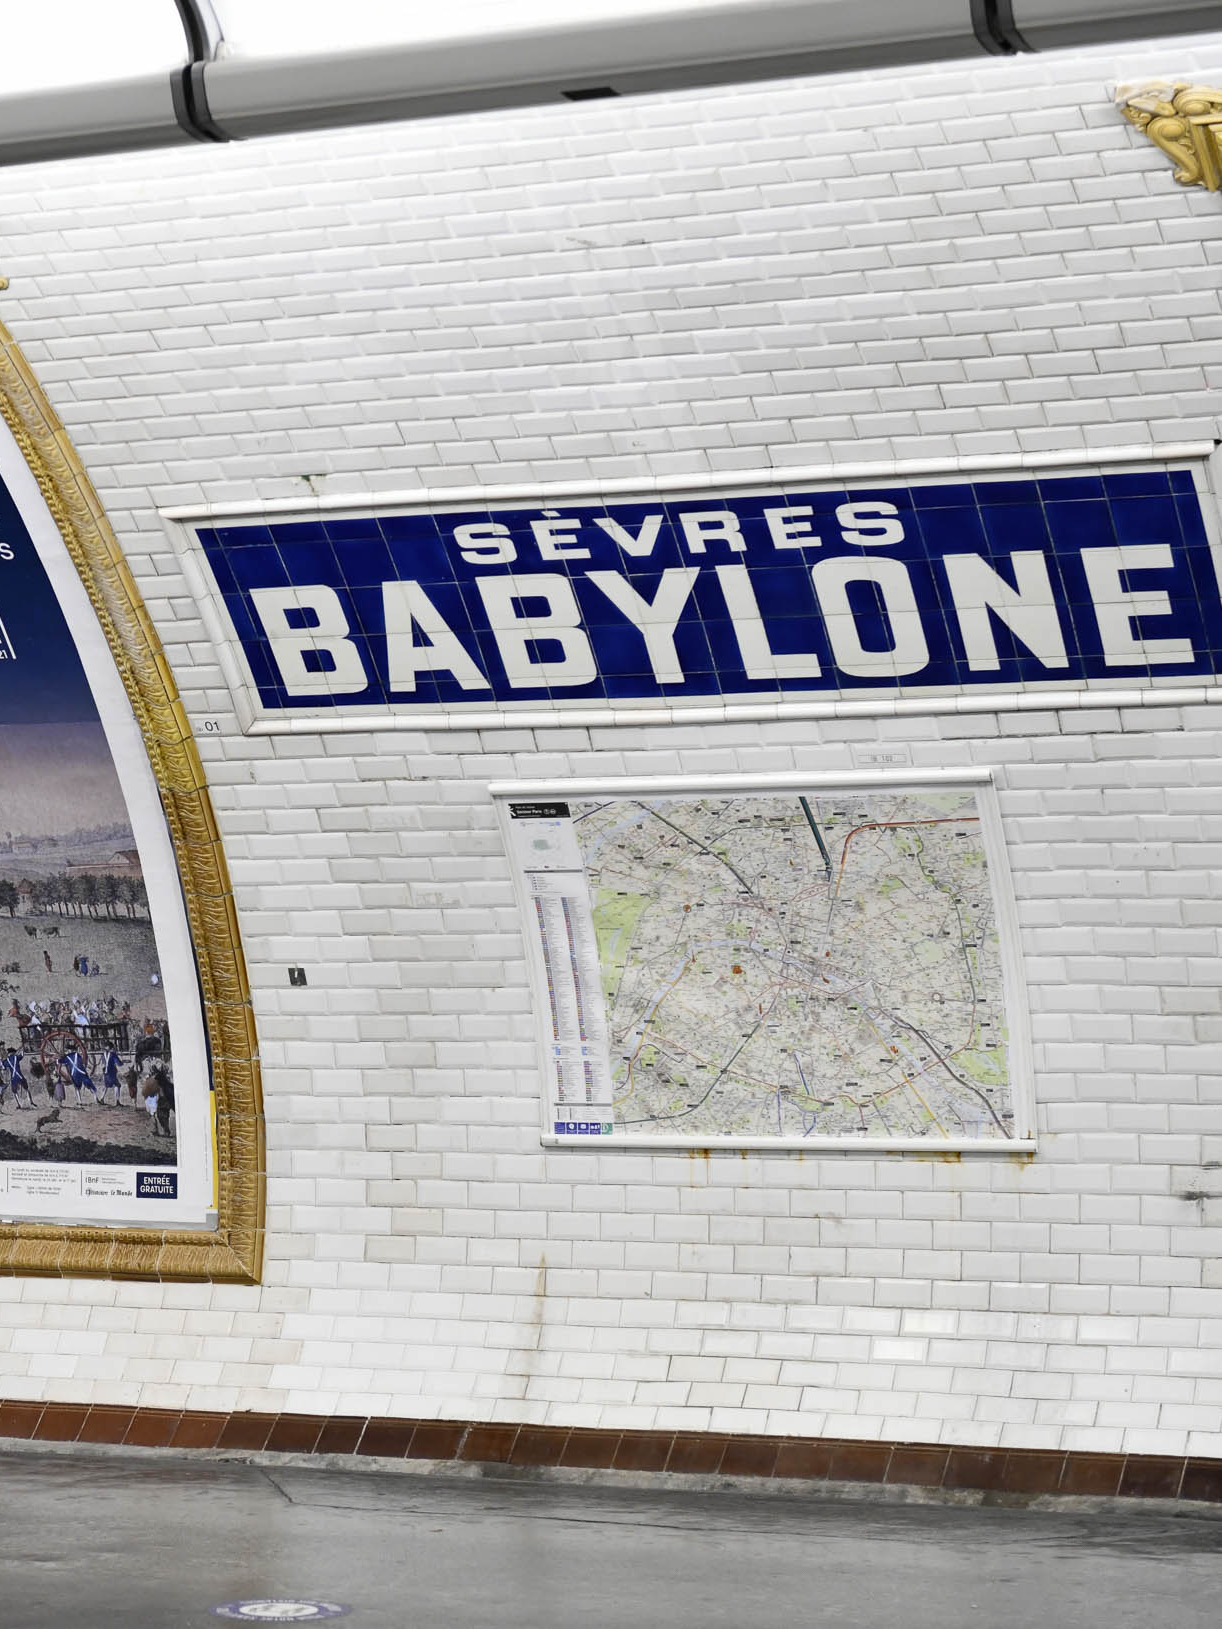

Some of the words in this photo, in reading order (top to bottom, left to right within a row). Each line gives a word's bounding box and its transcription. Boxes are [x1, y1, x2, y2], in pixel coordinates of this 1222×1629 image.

[455, 499, 906, 566] SÈVRES
[248, 542, 1198, 699] BABYLONE
[204, 721, 220, 732] 01
[143, 1175, 171, 1185] ENTRÉE
[140, 1185, 174, 1194] GRATUITE
